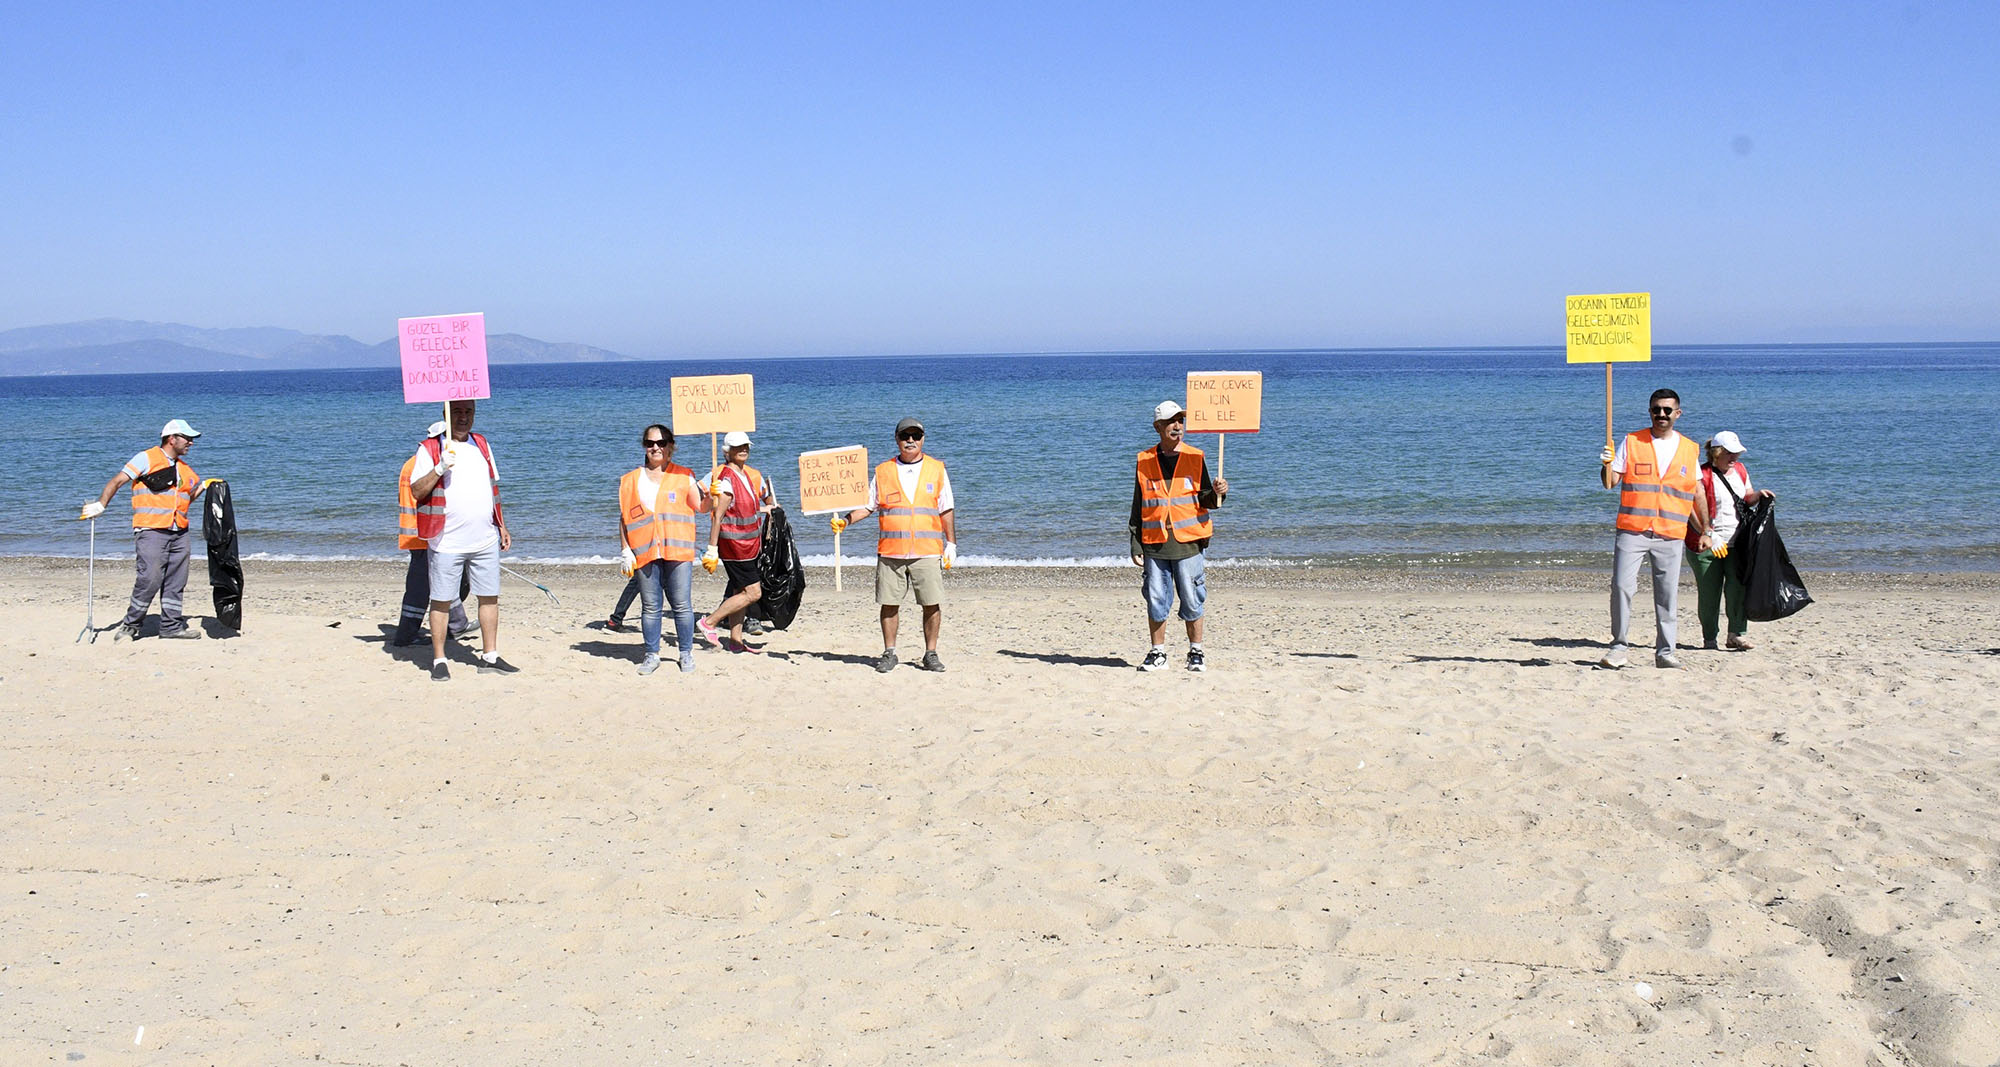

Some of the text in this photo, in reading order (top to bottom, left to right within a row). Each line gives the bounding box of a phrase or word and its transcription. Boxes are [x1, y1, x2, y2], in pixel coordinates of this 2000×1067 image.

[412, 336, 468, 352] GELECEK
[1194, 410, 1236, 421] EL ELE
